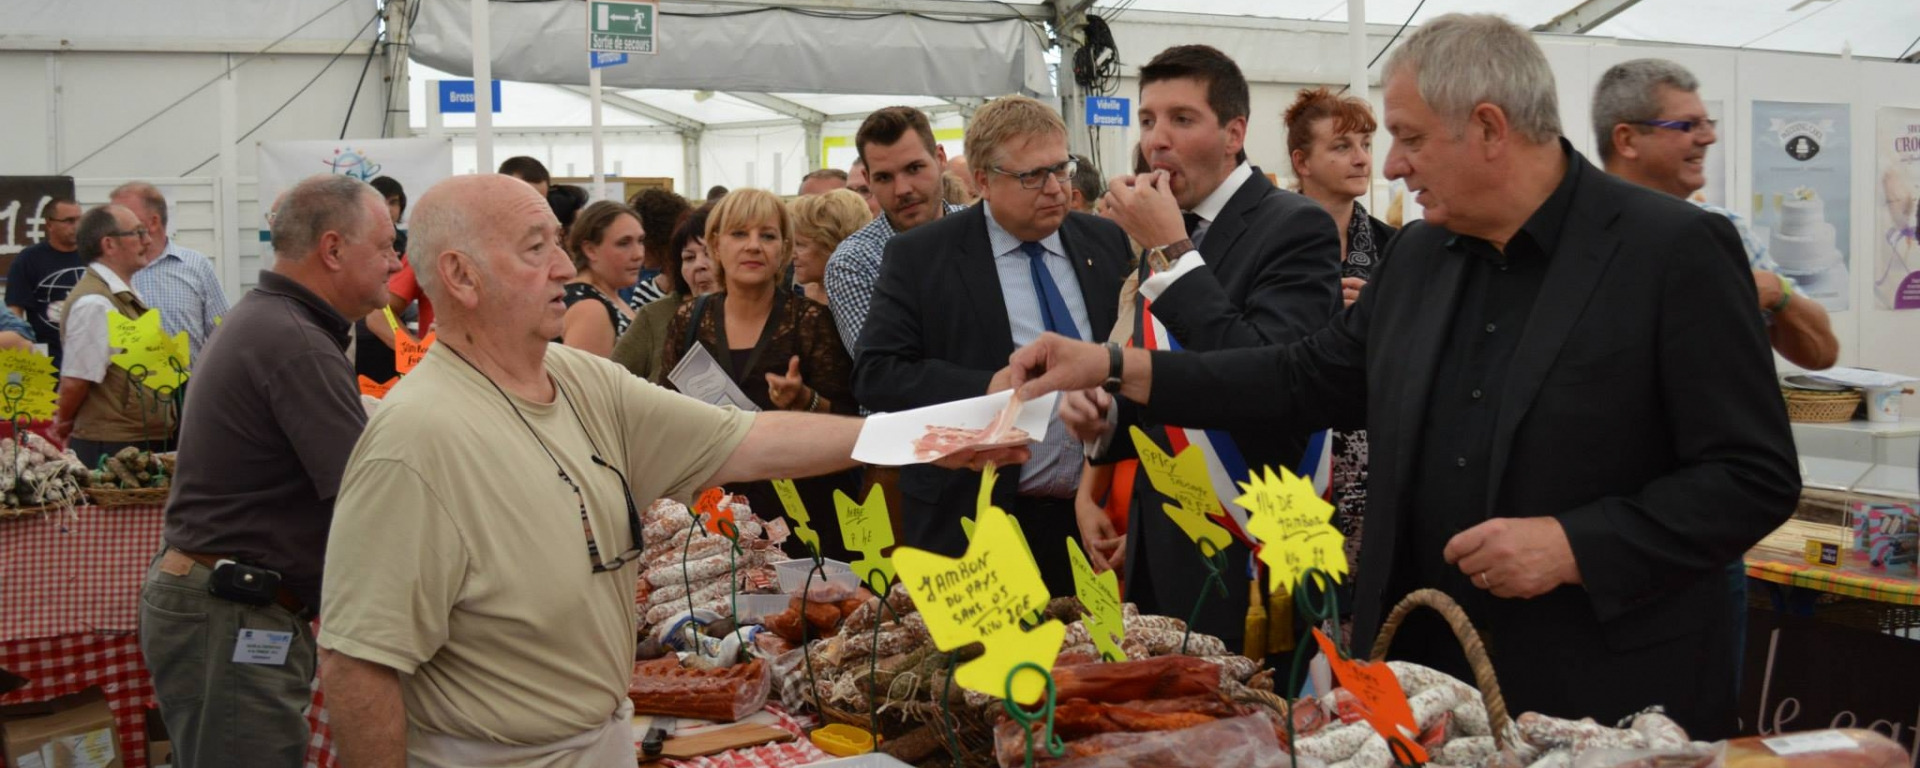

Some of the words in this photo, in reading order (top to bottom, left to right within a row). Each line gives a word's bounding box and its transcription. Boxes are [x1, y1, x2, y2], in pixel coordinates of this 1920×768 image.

[593, 33, 613, 49] Sortie
[615, 36, 622, 50] de
[624, 38, 650, 51] secours
[450, 91, 475, 103] Brass
[1093, 113, 1123, 125] Brasserie
[1276, 494, 1293, 512] DE
[918, 551, 990, 602] JAMBON
[965, 570, 998, 598] PAYS
[991, 585, 1009, 605] OS
